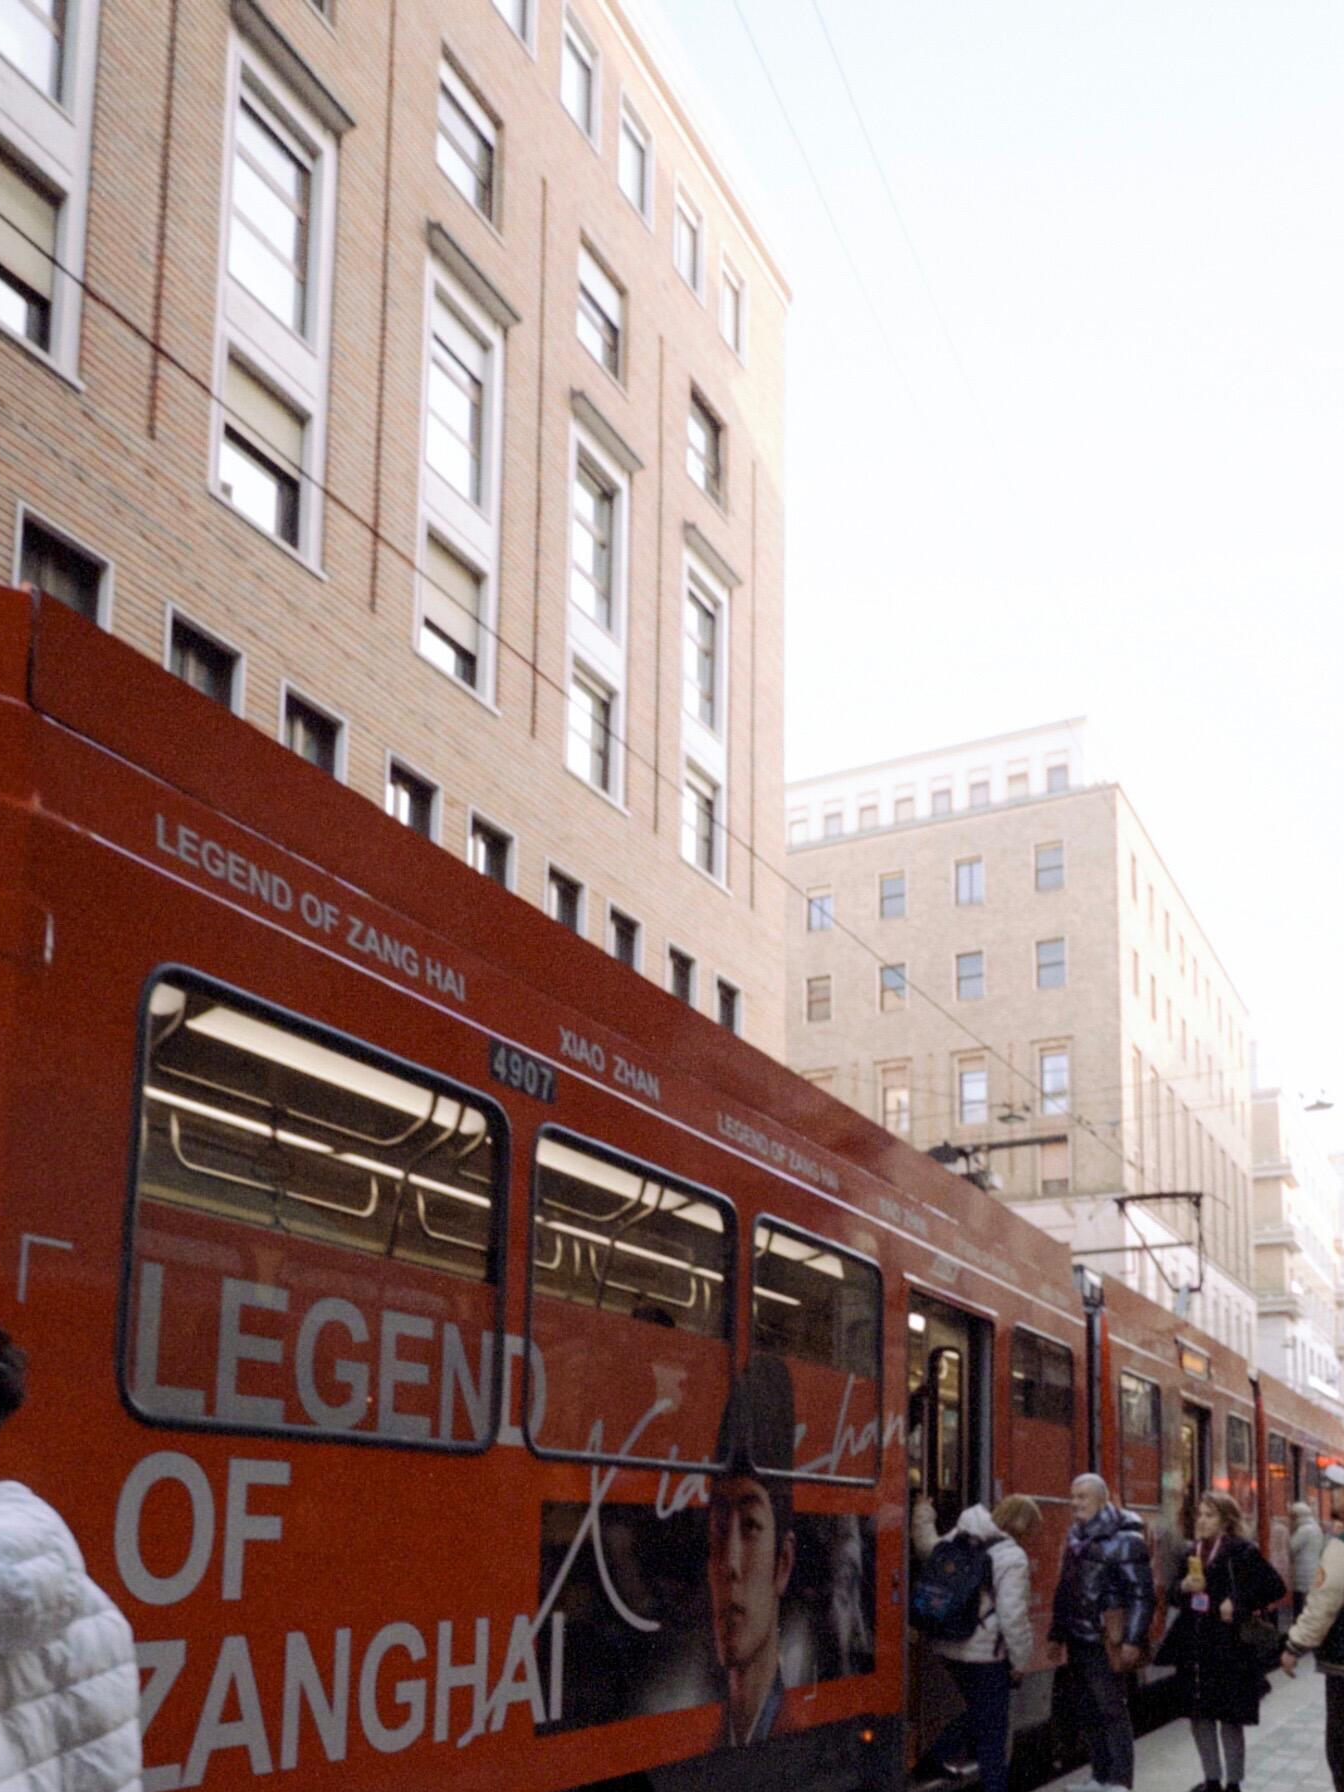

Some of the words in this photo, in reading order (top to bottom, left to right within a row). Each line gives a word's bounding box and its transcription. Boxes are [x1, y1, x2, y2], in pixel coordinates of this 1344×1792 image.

[156, 813, 292, 912] LEGEND
[300, 891, 340, 934] OF
[346, 914, 419, 978] ZANG
[425, 957, 466, 1003] HAI
[493, 1049, 553, 1100] 4907
[559, 1025, 605, 1073] XIAO
[612, 1055, 660, 1101] ZHAN
[135, 1261, 547, 1448] LEGEND
[113, 1449, 292, 1607] OF
